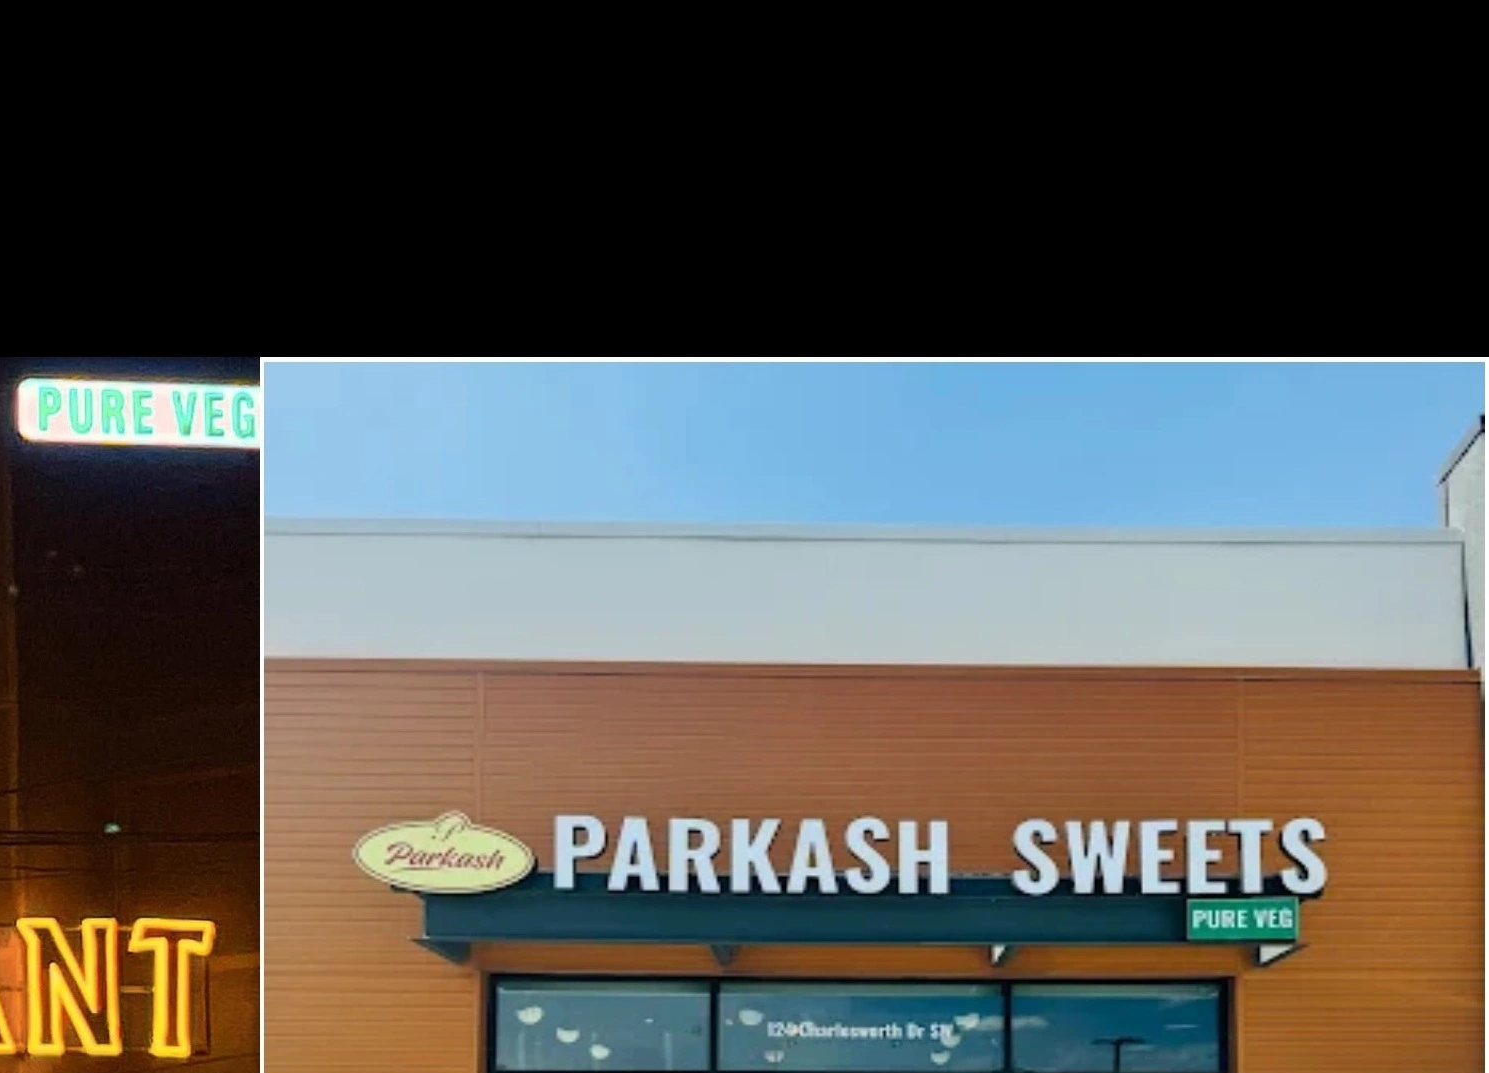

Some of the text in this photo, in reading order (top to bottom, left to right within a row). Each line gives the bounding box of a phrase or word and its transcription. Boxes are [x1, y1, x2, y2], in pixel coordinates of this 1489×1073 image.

[36, 386, 255, 439] PURE VEG
[385, 841, 505, 871] Parkash
[553, 815, 1328, 896] PARKASH SWEETS
[1192, 908, 1294, 929] PURE VEG
